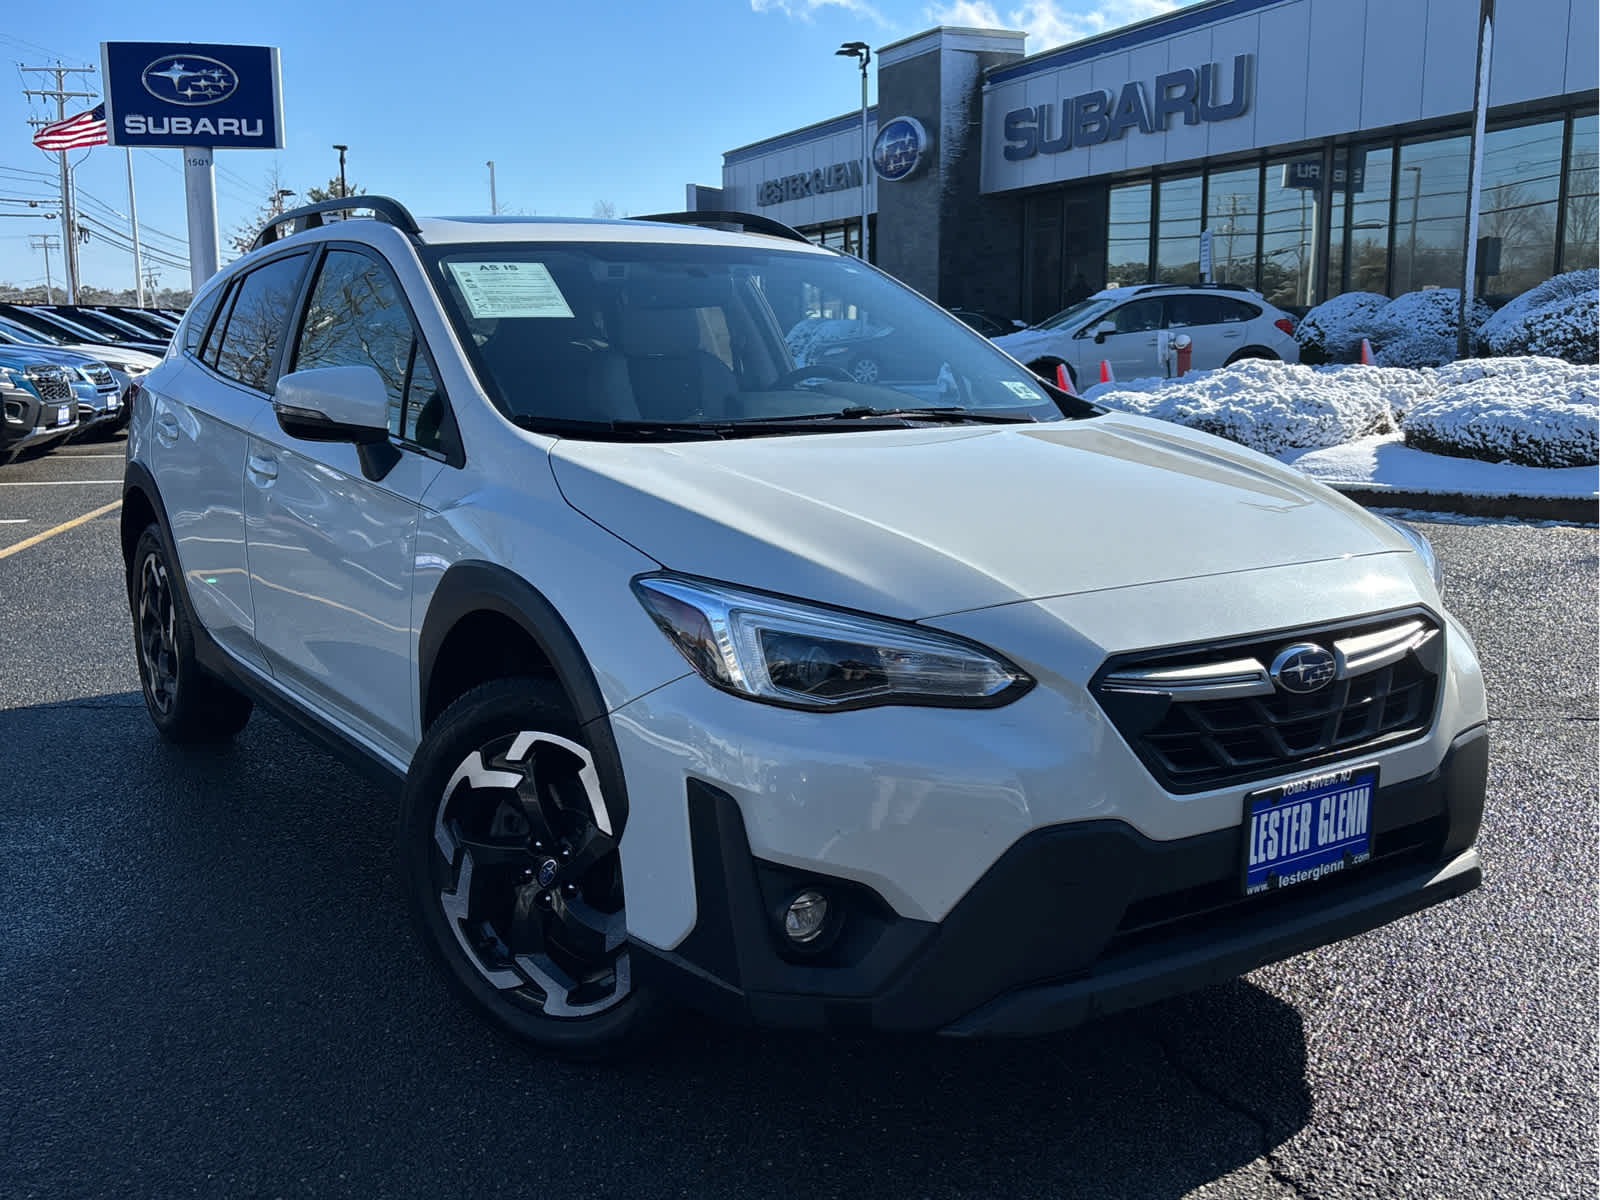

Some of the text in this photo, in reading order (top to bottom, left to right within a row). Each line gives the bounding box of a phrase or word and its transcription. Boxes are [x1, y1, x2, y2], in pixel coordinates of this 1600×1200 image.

[1003, 53, 1254, 162] SUBARU
[124, 114, 263, 137] SUBARU
[187, 158, 209, 168] 1501
[757, 171, 812, 207] LESTER
[479, 264, 519, 272] AS IS
[1282, 780, 1309, 797] TOMS
[1340, 768, 1353, 782] NJ
[1249, 787, 1370, 866] LESTER GLENN
